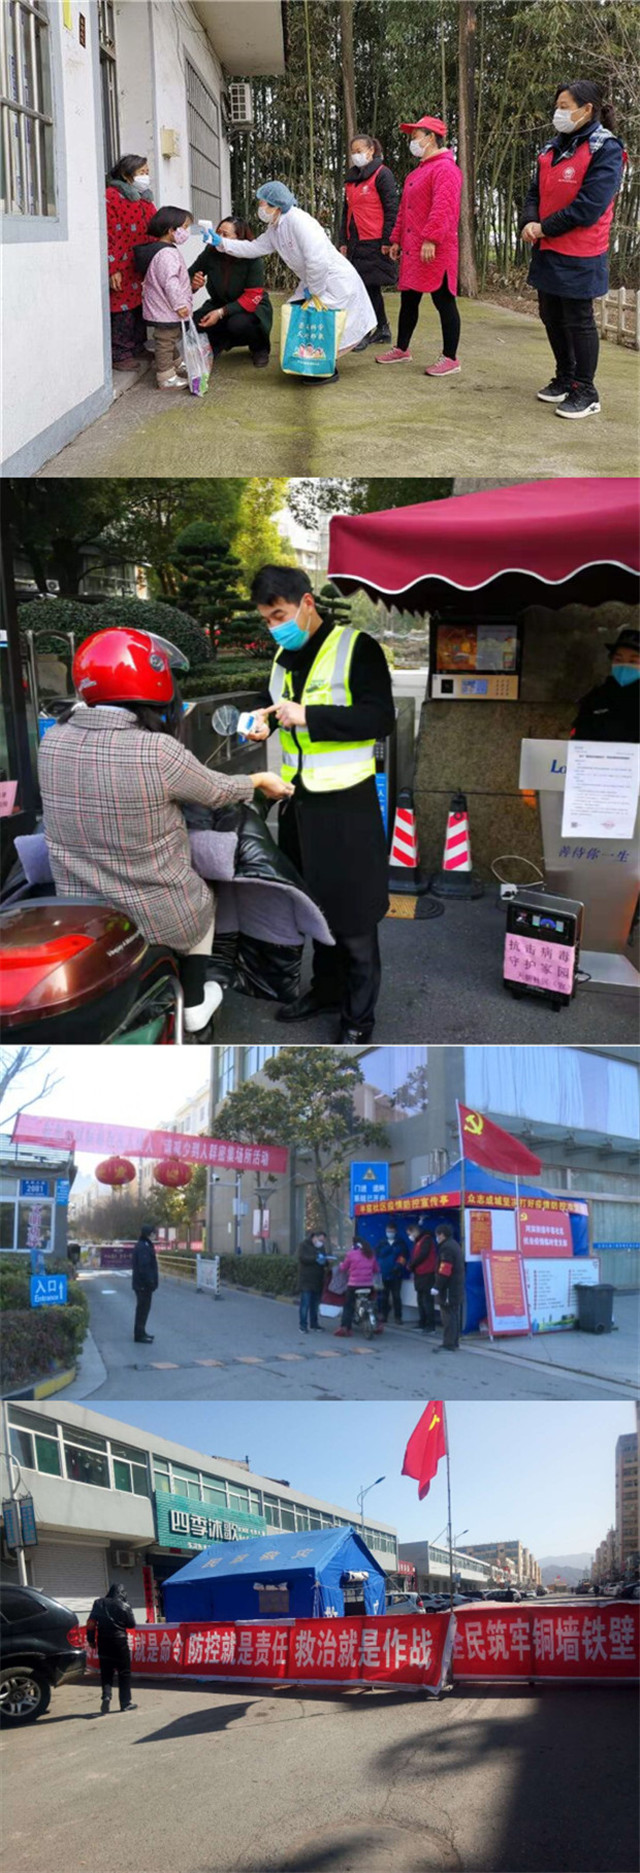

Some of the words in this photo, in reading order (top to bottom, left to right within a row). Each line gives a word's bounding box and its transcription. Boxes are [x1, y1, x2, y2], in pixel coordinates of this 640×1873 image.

[509, 940, 569, 962] 抗击病毒
[509, 956, 570, 978] 守护家园
[36, 1280, 57, 1293] 入口
[170, 1509, 239, 1541] 四季沐歌
[188, 1630, 288, 1667] 防控就是责任
[294, 1627, 433, 1671] 救治就是作战
[452, 1615, 636, 1662] 全民筑牢铜墙铁壁
